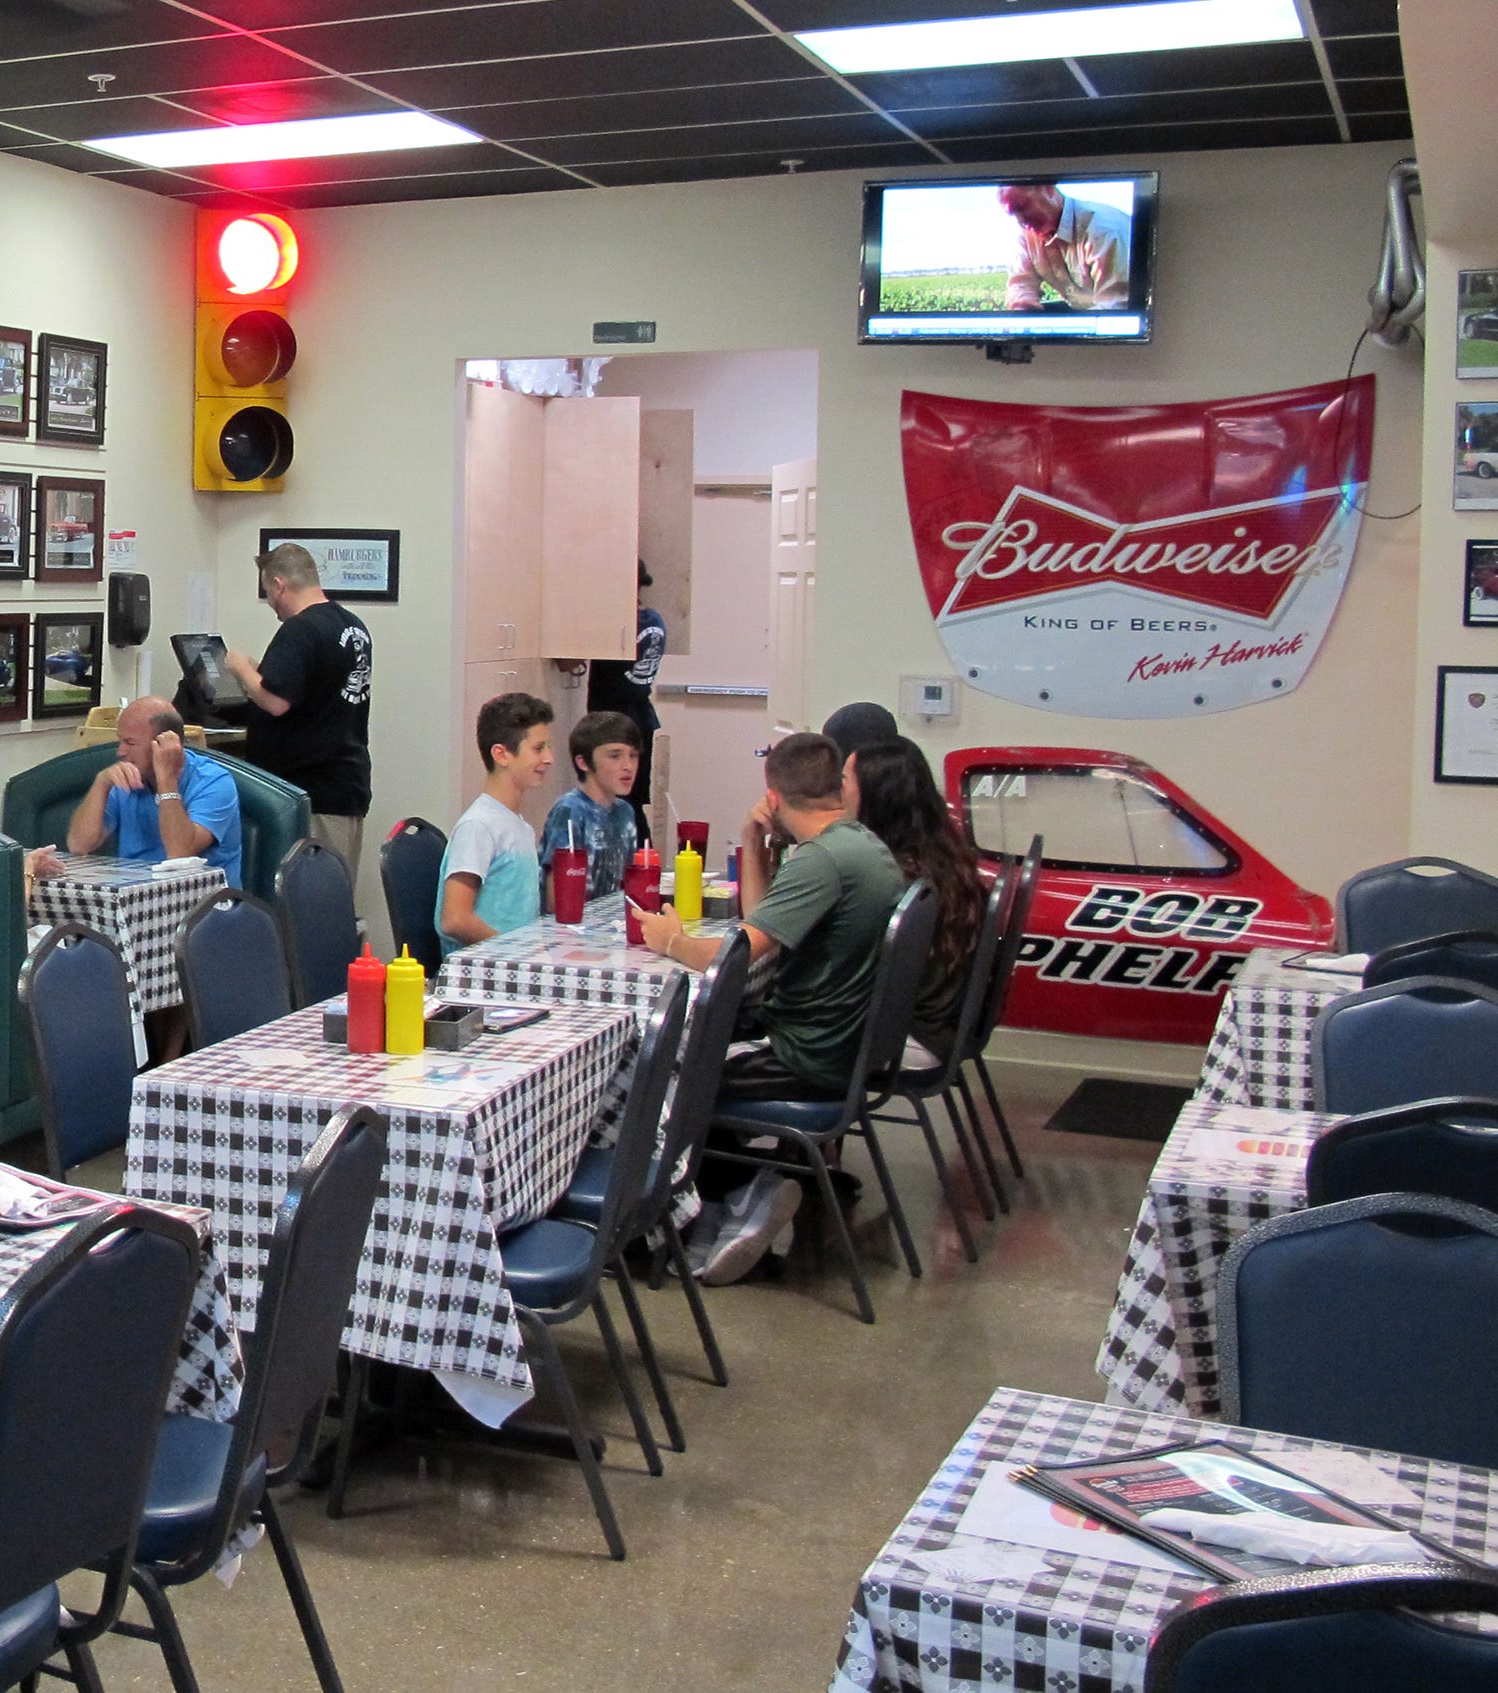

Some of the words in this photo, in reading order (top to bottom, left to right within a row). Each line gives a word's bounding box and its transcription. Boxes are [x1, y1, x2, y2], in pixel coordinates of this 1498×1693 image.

[941, 517, 1342, 581] Budweiser
[1127, 655, 1199, 683] Kevin
[971, 774, 1027, 798] A/A
[1064, 884, 1264, 943] BOB
